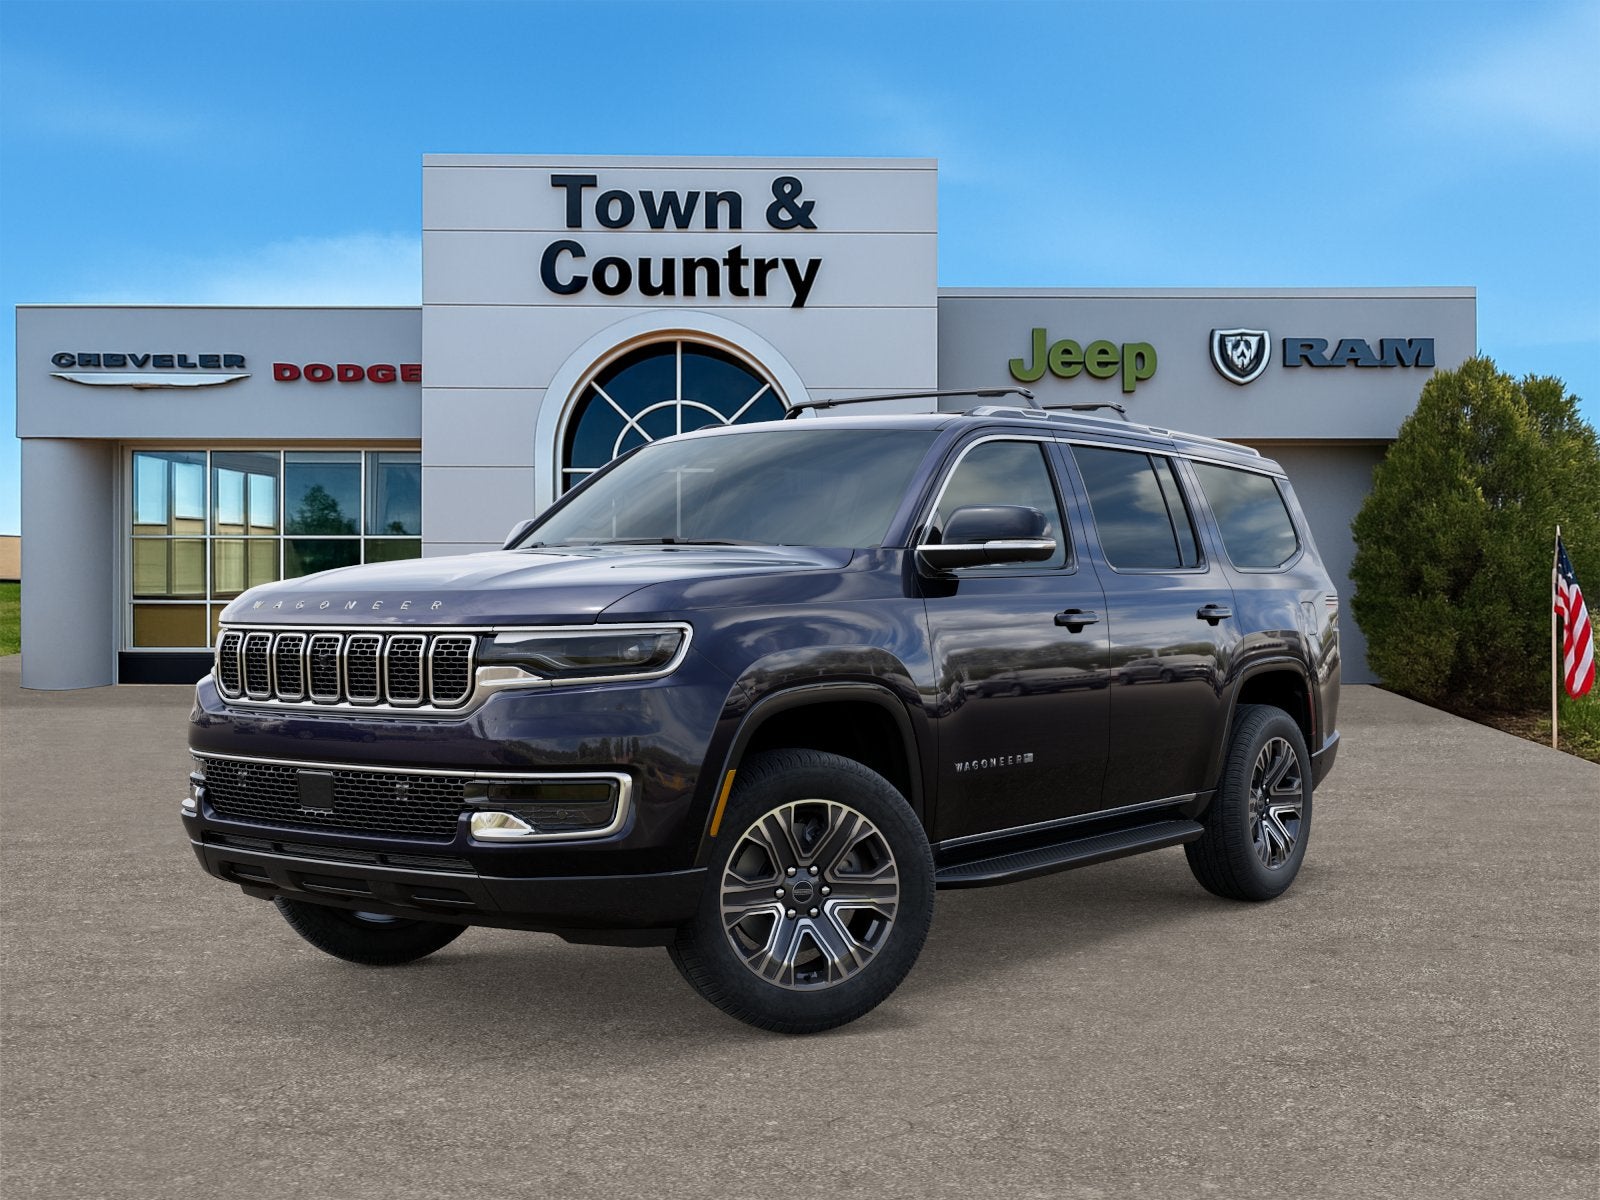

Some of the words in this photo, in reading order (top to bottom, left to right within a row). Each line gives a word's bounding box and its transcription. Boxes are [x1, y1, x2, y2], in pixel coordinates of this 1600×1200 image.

[550, 173, 743, 230] Town
[765, 175, 819, 230] &
[539, 239, 823, 309] Country
[1009, 327, 1158, 393] Jeep
[1282, 336, 1436, 368] RAM
[272, 362, 422, 383] DODGE
[252, 600, 443, 611] WAGONEER
[954, 753, 1022, 773] WAGONEER
